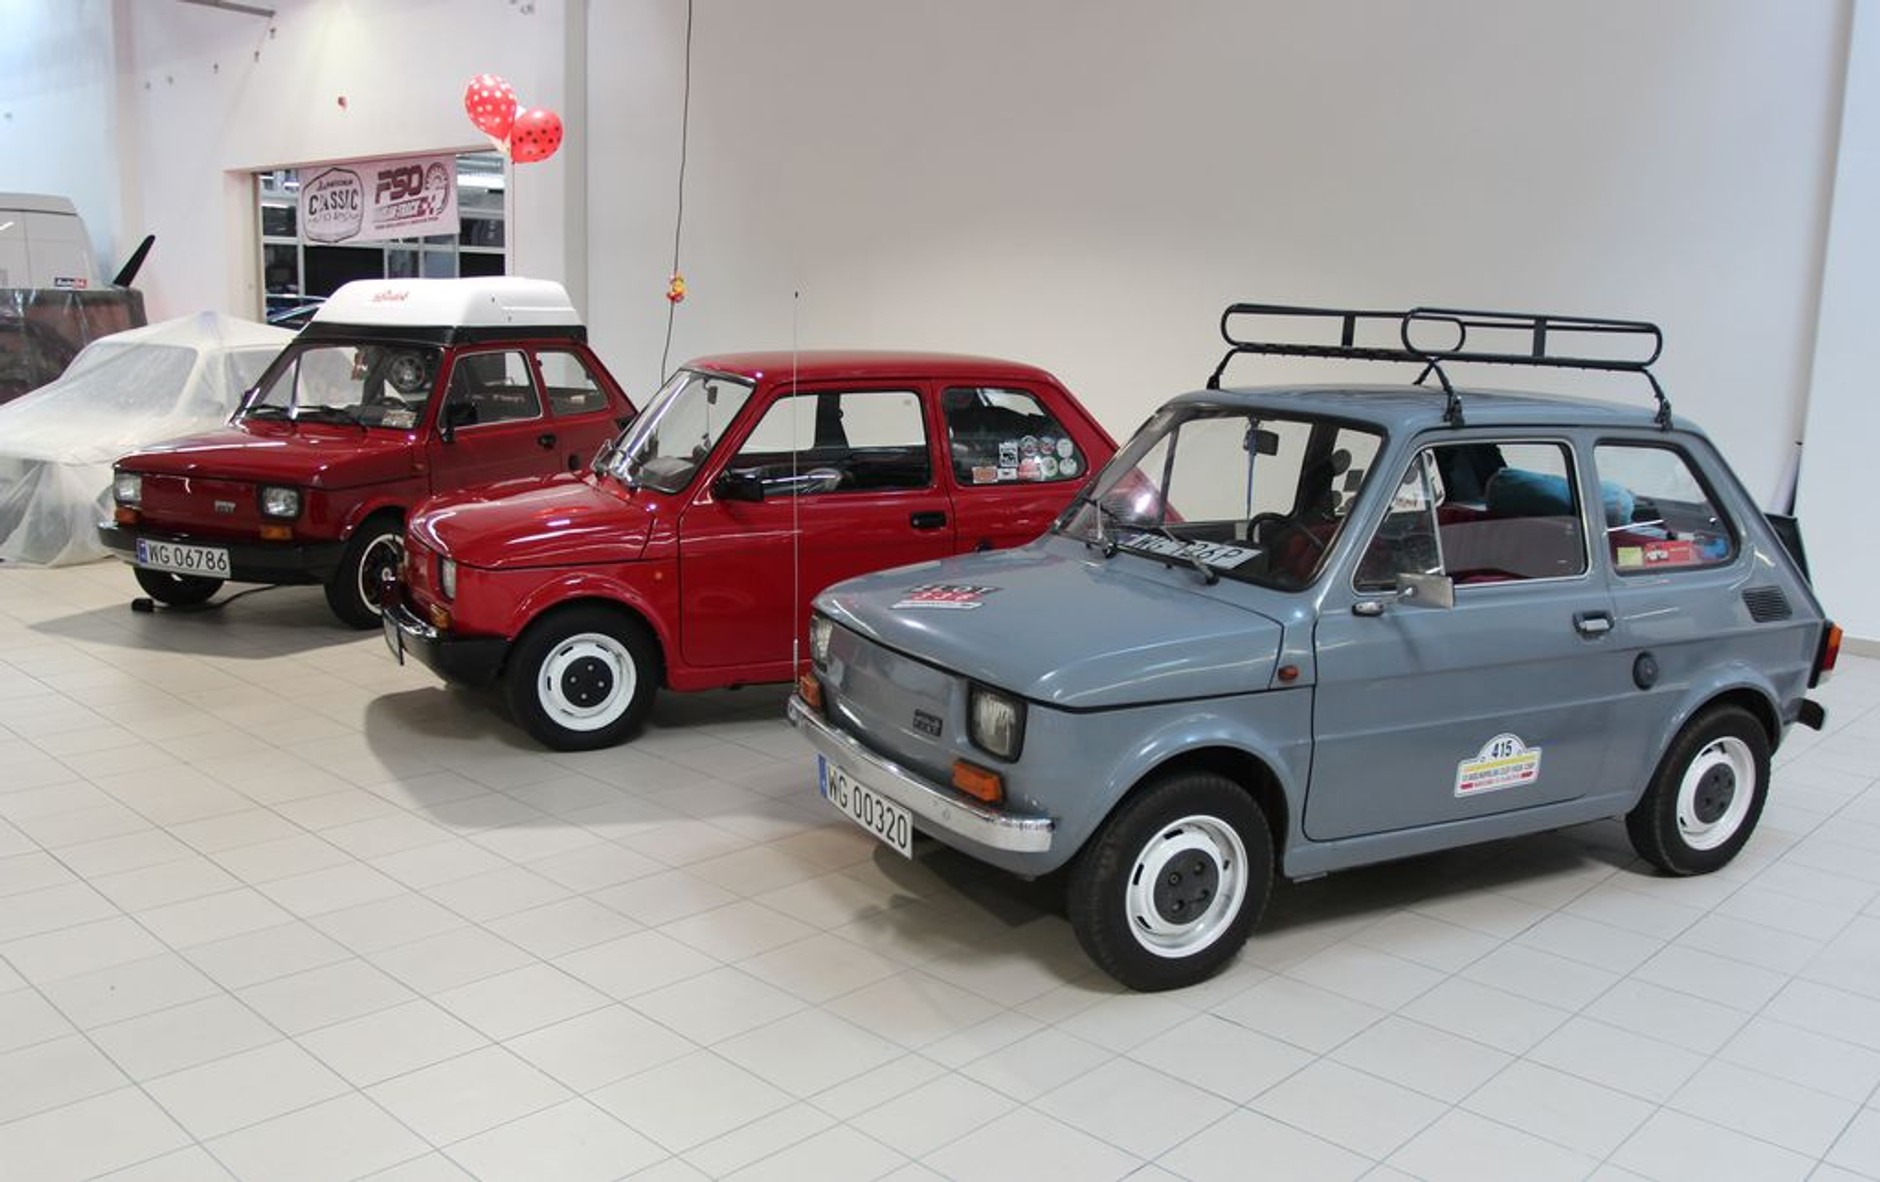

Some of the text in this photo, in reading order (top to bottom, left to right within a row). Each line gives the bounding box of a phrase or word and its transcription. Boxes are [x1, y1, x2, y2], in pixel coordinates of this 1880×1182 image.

[375, 164, 423, 204] FSO
[148, 543, 227, 571] WG 06786
[1492, 740, 1512, 758] 415
[828, 765, 908, 850] WG 00320
